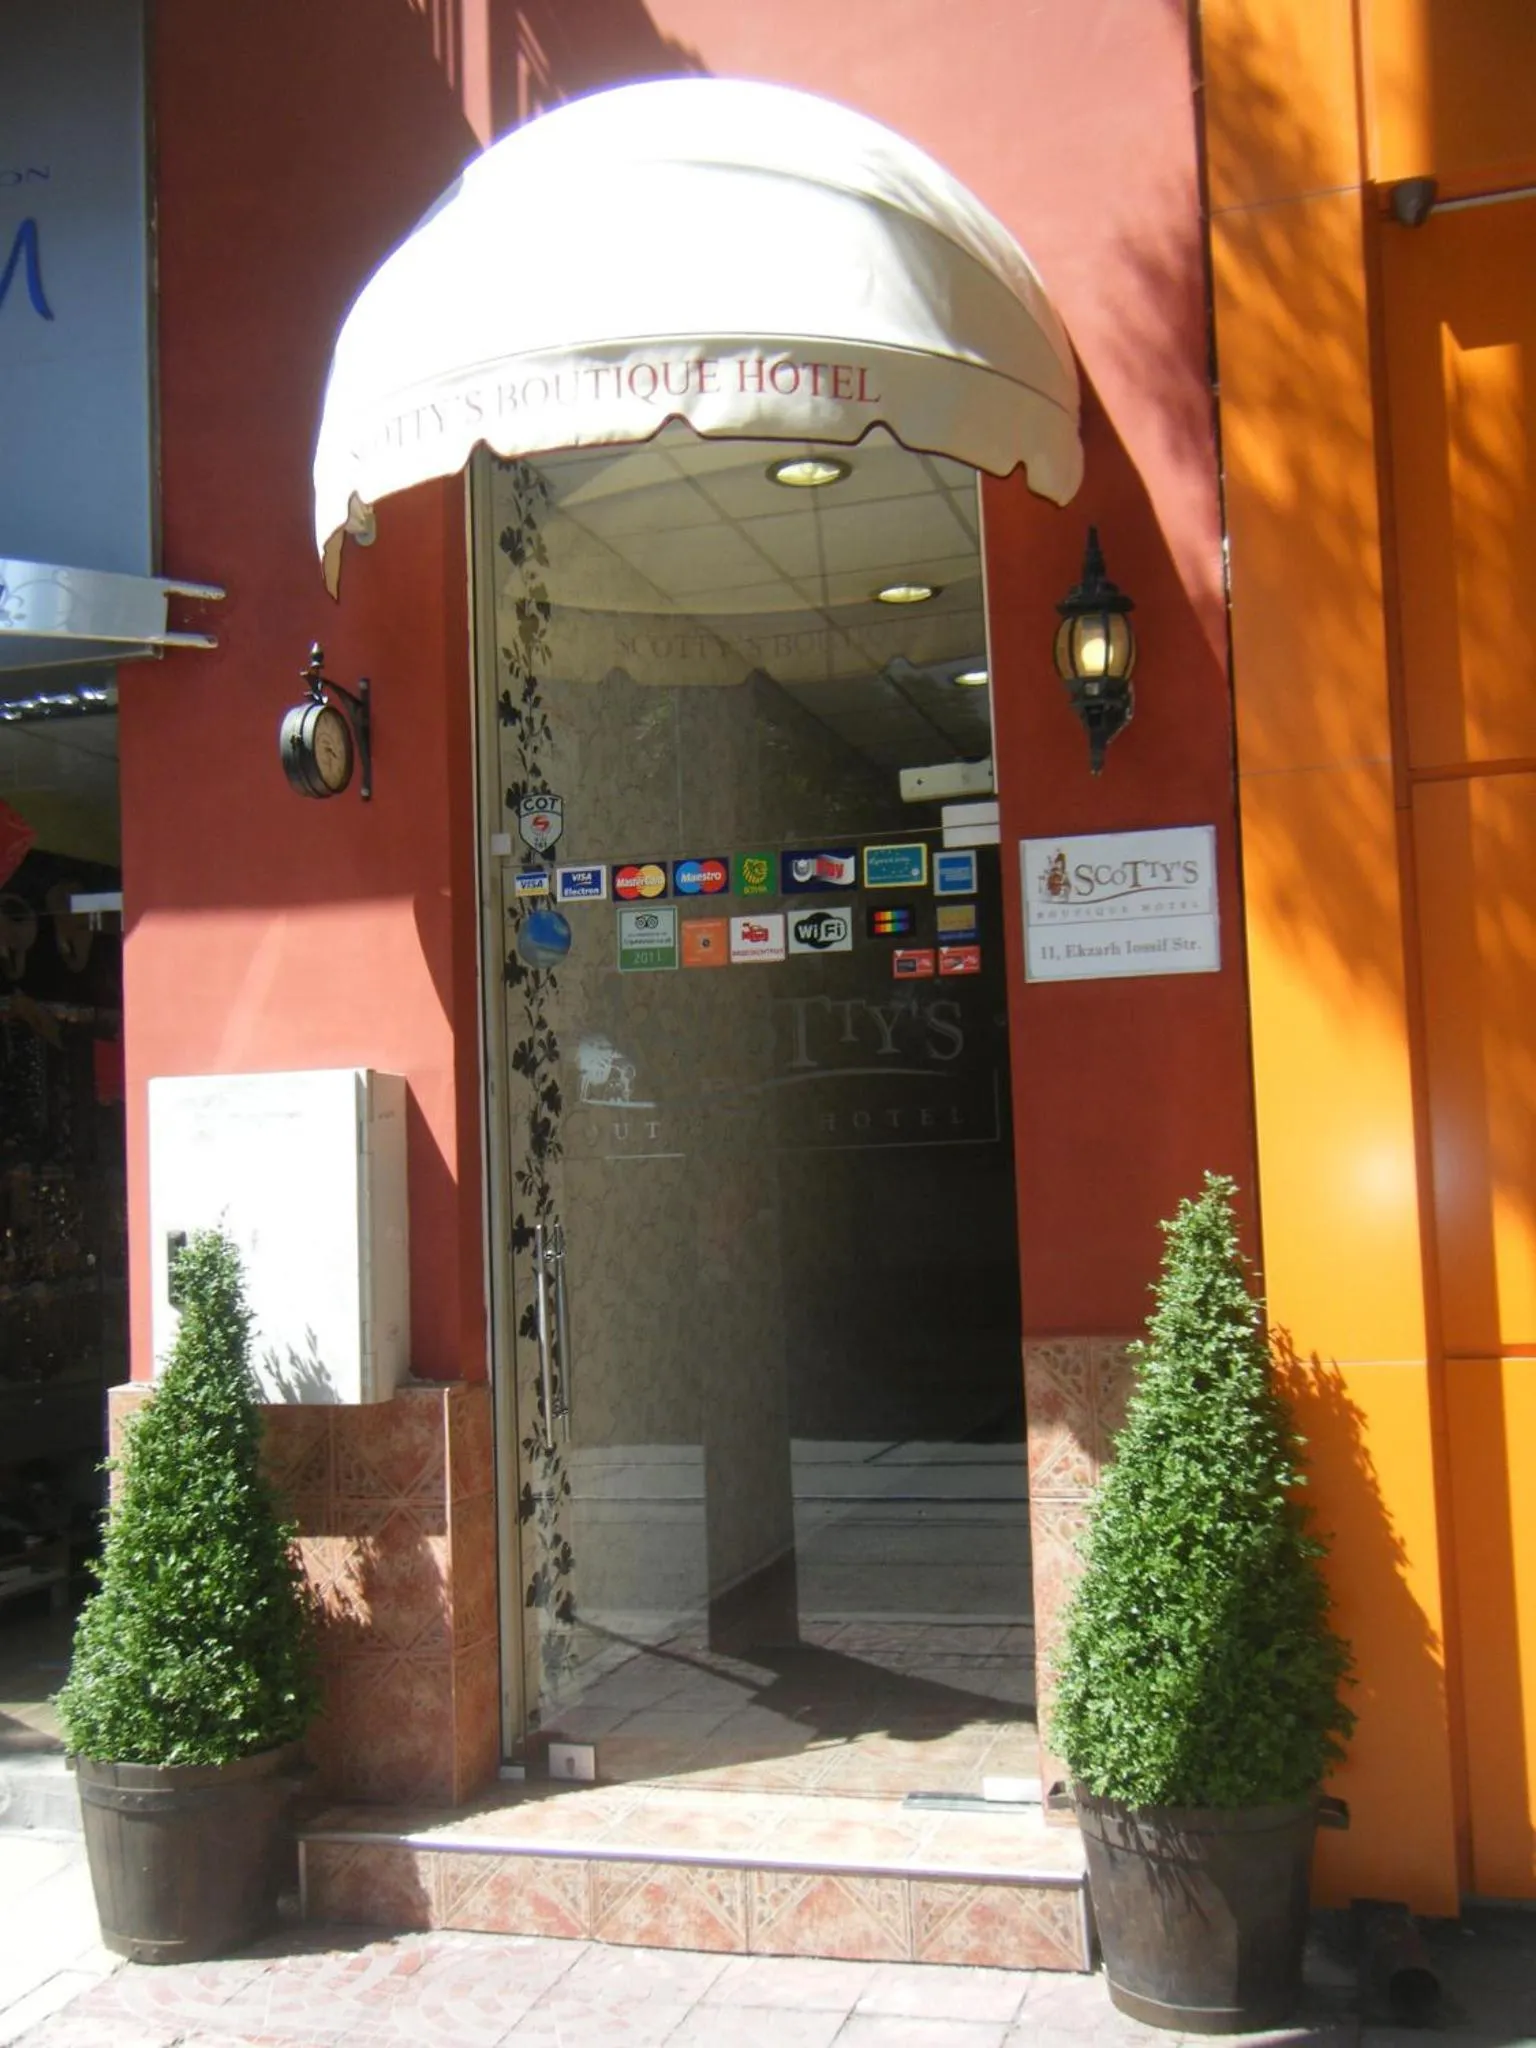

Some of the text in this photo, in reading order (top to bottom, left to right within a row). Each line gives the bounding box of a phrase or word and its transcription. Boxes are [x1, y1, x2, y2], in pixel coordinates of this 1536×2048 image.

[349, 358, 882, 463] OTTY'S BOUTIQUE HOTEL
[523, 797, 559, 812] COT
[571, 872, 593, 882] VISA
[680, 867, 723, 884] Maestro
[1074, 859, 1200, 897] SCOTTY'S
[520, 879, 545, 890] VISA
[563, 887, 601, 899] Electron
[772, 994, 965, 1068] TTY'S
